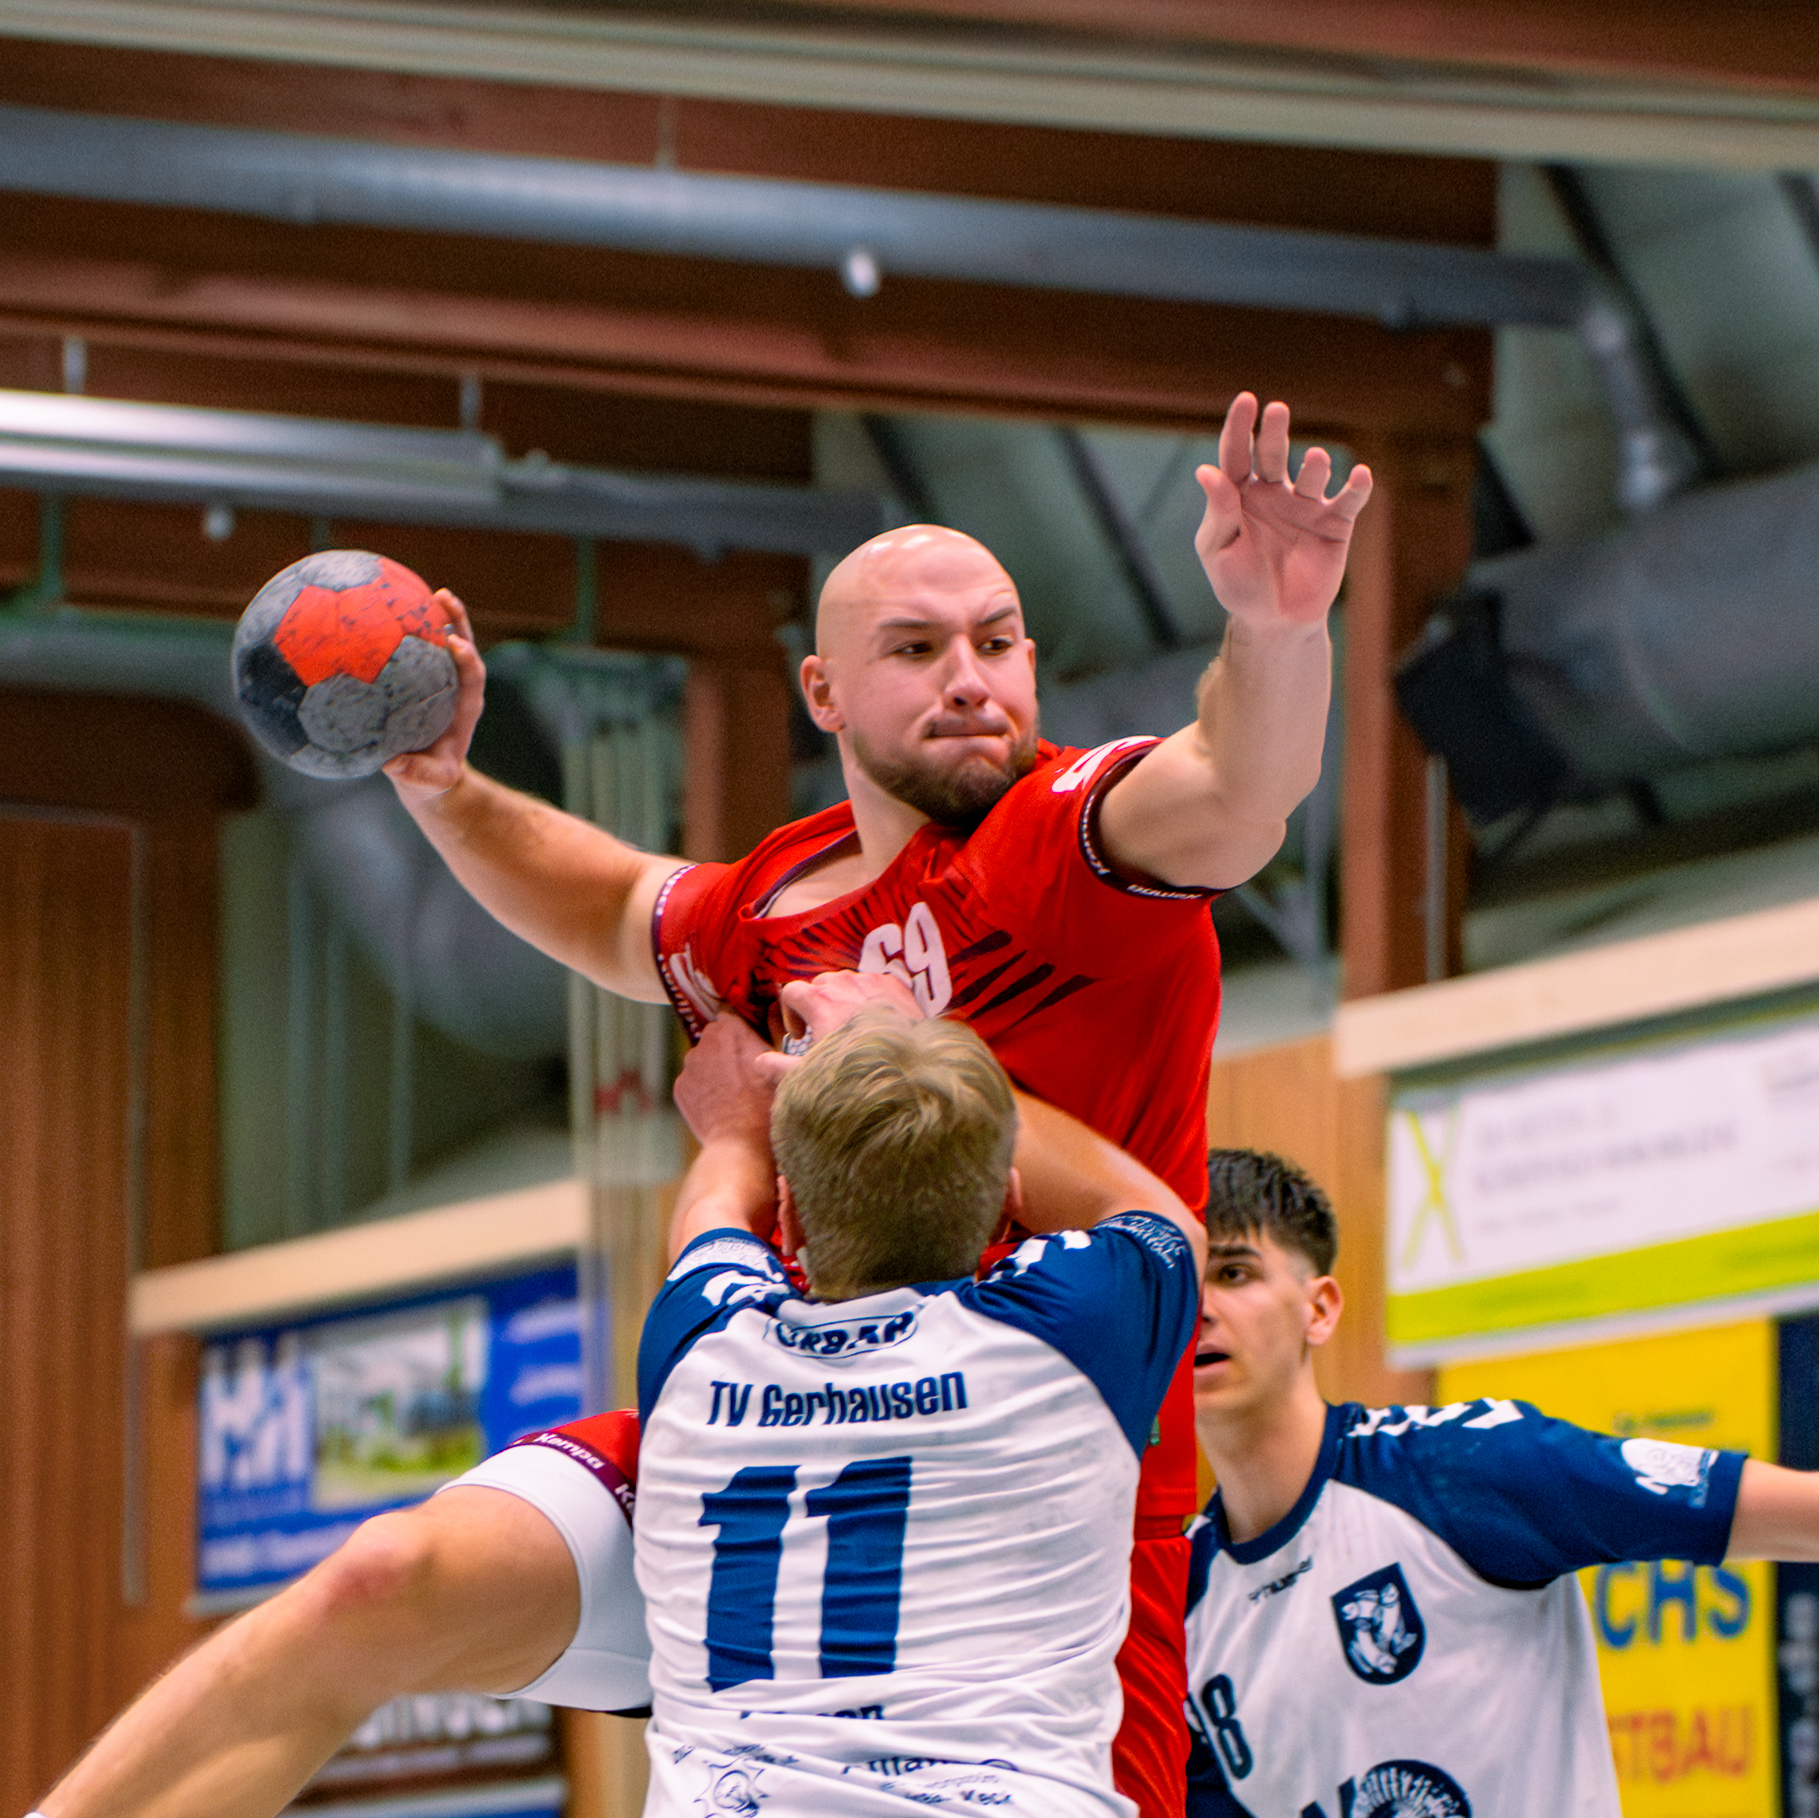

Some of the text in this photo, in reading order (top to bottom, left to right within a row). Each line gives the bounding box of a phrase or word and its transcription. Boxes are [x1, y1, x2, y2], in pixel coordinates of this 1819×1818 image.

[706, 1370, 969, 1428] TV Gerhausen
[698, 1456, 913, 1693] 11
